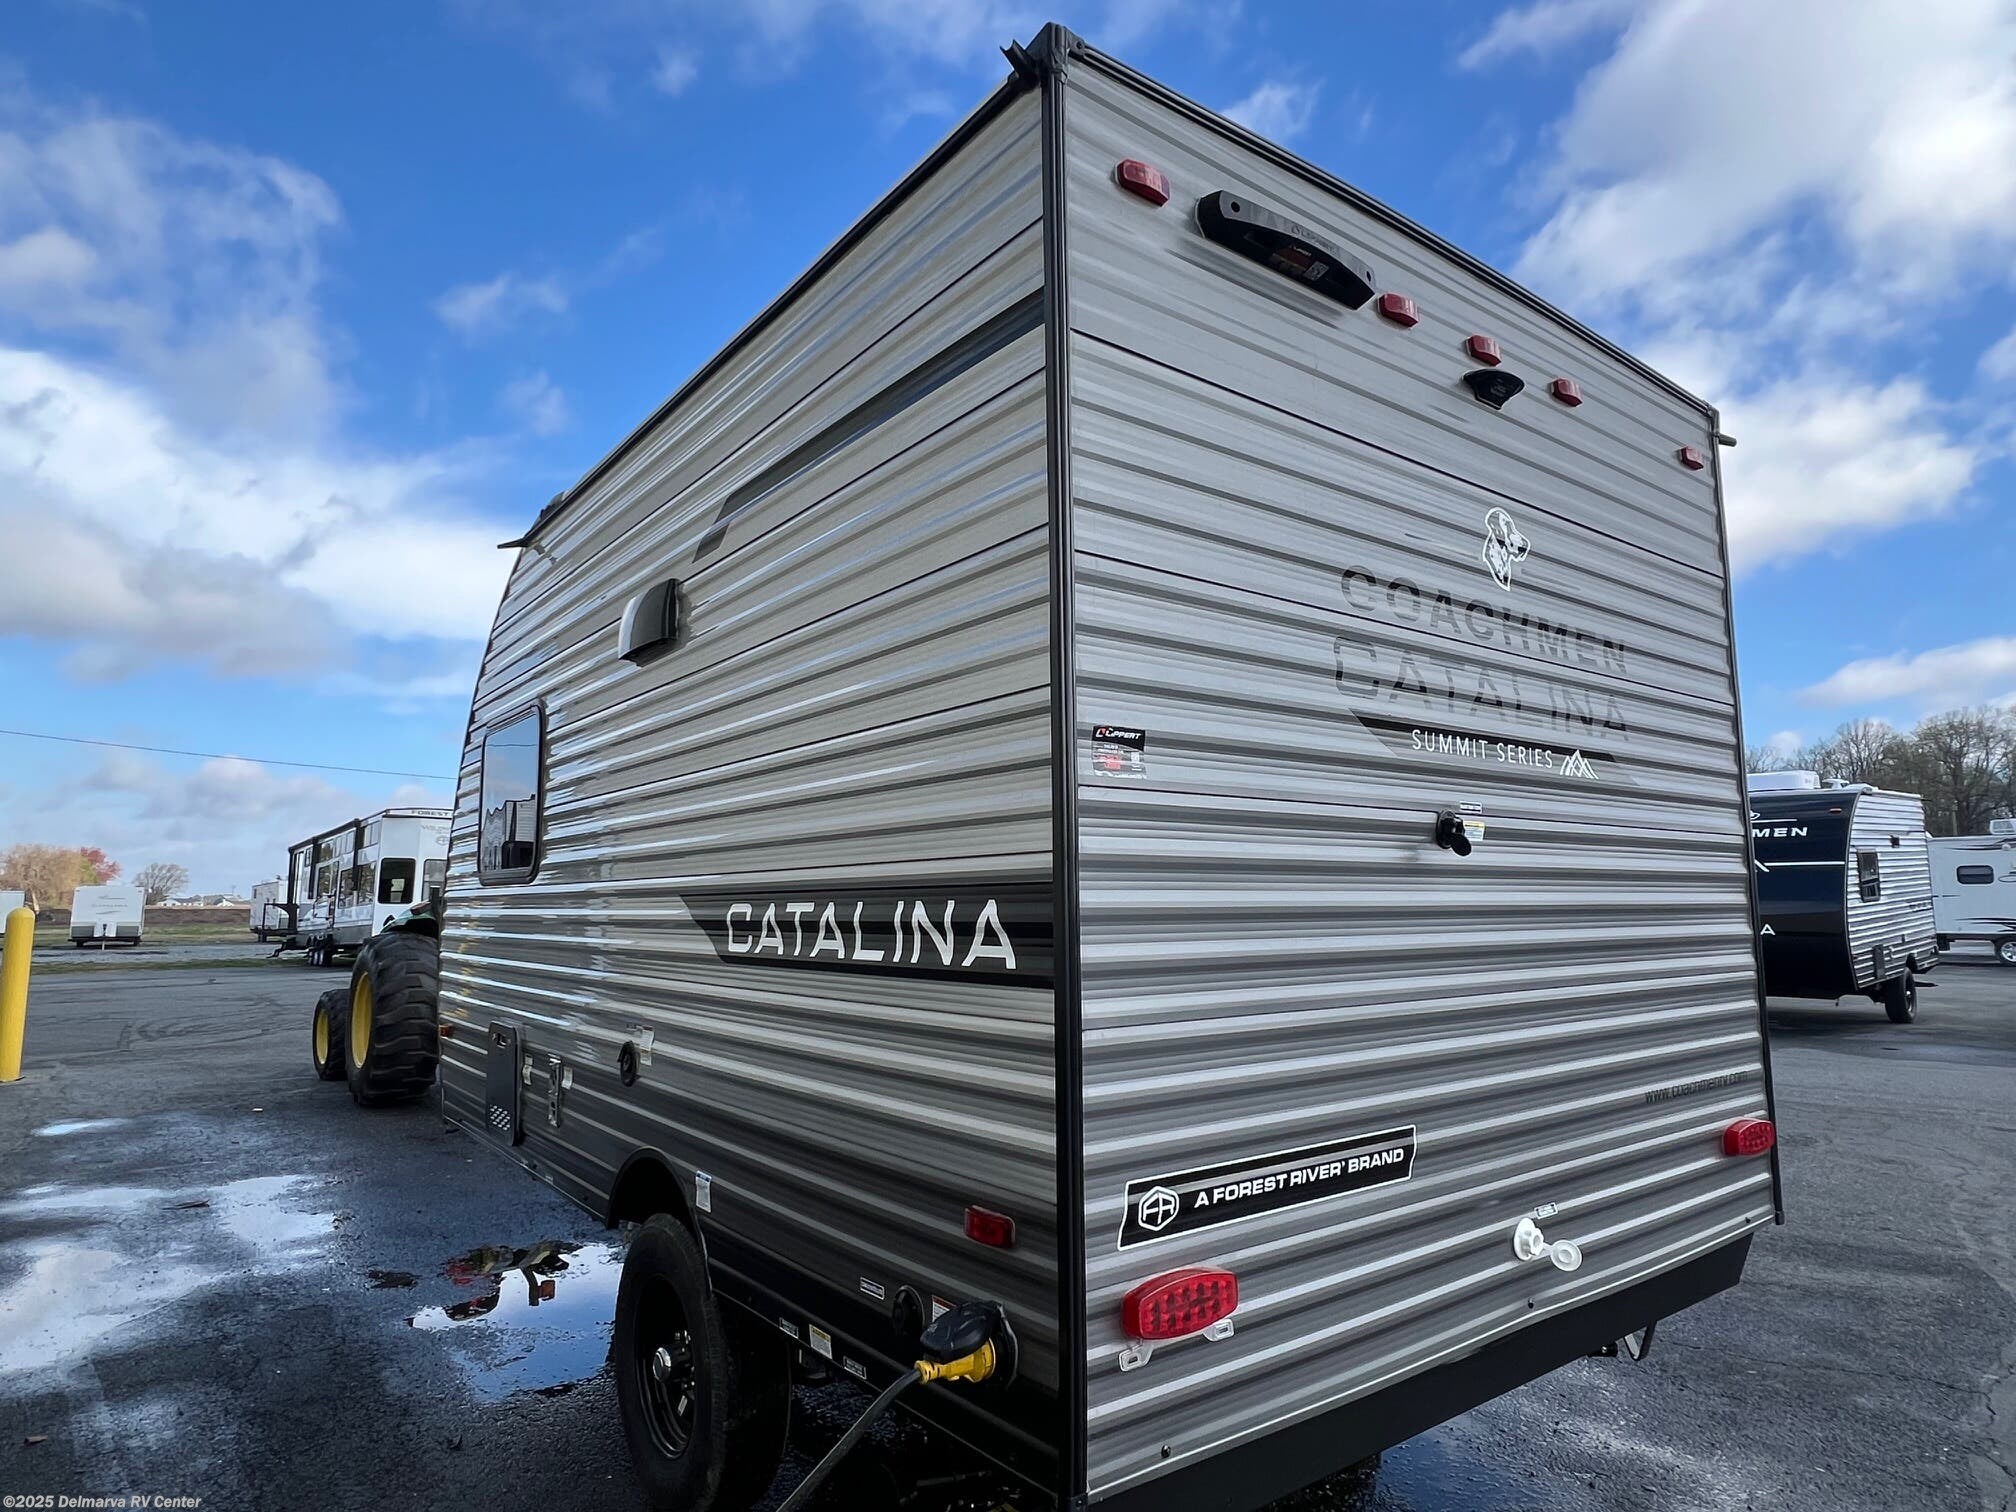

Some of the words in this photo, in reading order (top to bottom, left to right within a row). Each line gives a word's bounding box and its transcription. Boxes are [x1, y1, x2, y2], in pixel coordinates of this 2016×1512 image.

[1341, 565, 1628, 675] COACHMEN
[1333, 635, 1629, 742] CATALINA
[1411, 728, 1488, 760] SUMMIT
[1496, 742, 1553, 769] SERIES
[726, 899, 1016, 970] CATALINA
[1194, 1191, 1210, 1209] A
[1213, 1173, 1288, 1204] FOREST
[1290, 1163, 1343, 1187] RIVER
[1347, 1148, 1404, 1172] BRAND
